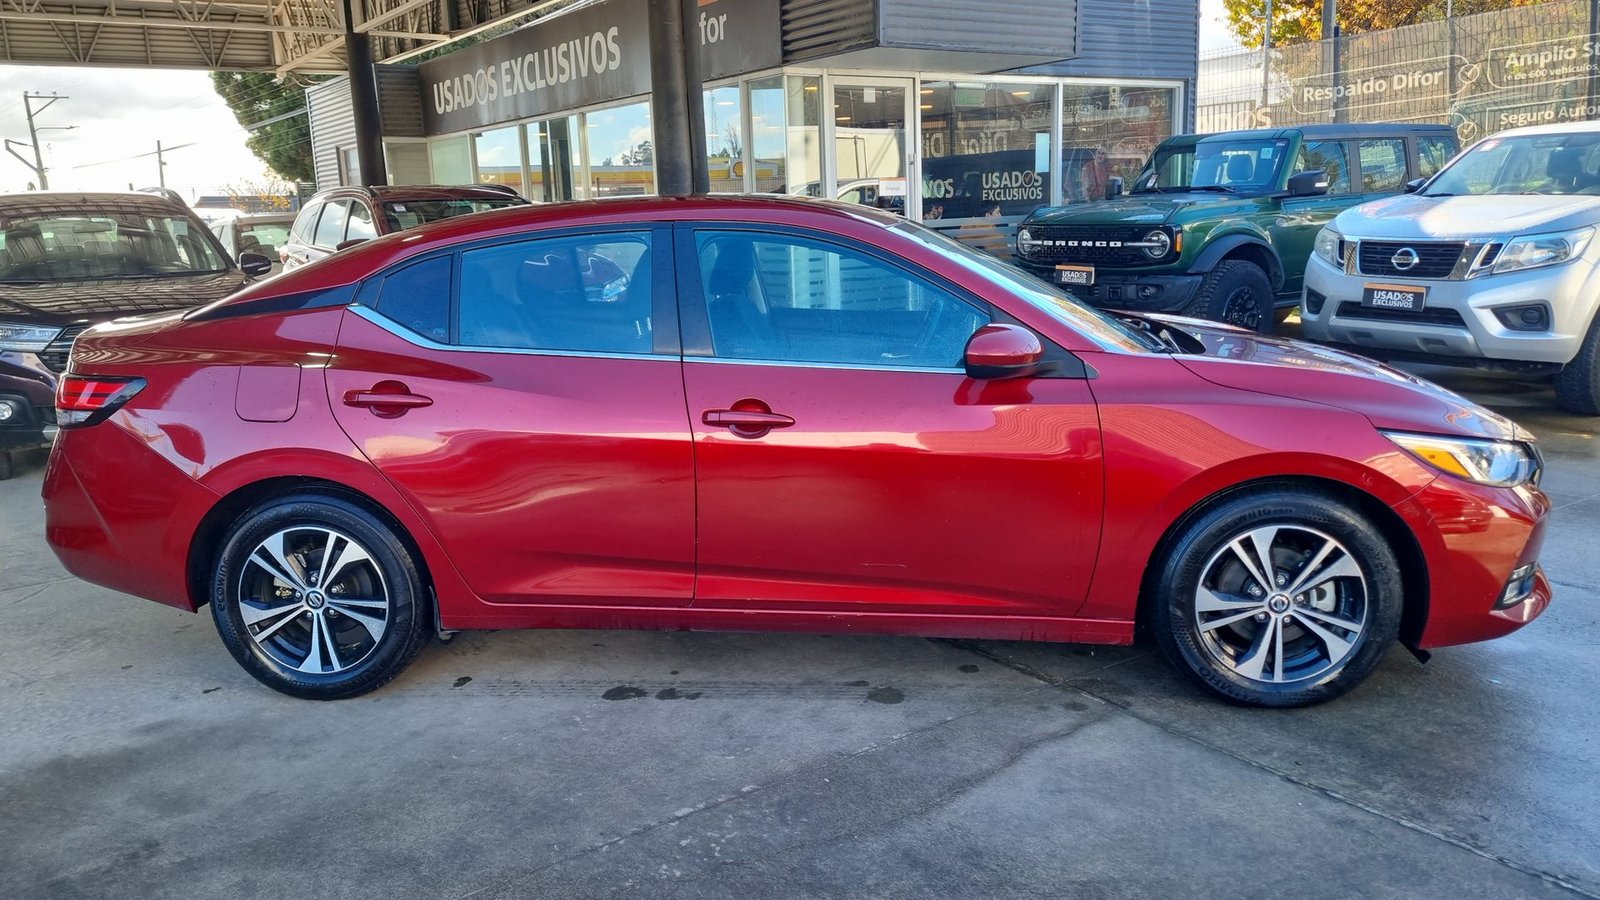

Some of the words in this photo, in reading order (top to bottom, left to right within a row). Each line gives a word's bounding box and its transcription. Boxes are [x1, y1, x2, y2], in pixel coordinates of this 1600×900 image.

[699, 11, 727, 46] for
[1505, 45, 1577, 68] Amplio
[433, 65, 498, 115] USADOS
[501, 26, 621, 98] EXCLUSIVOS
[1528, 69, 1548, 78] 600
[1303, 77, 1387, 102] Respaldo
[1393, 70, 1444, 91] Difor
[1500, 110, 1555, 126] Seguro
[982, 170, 1043, 189] USADOS
[982, 187, 1043, 201] EXCLUSIVOS
[1062, 270, 1087, 279] USADOS
[1372, 298, 1413, 309] EXCLUSIVOS
[1373, 290, 1414, 302] USADOS
